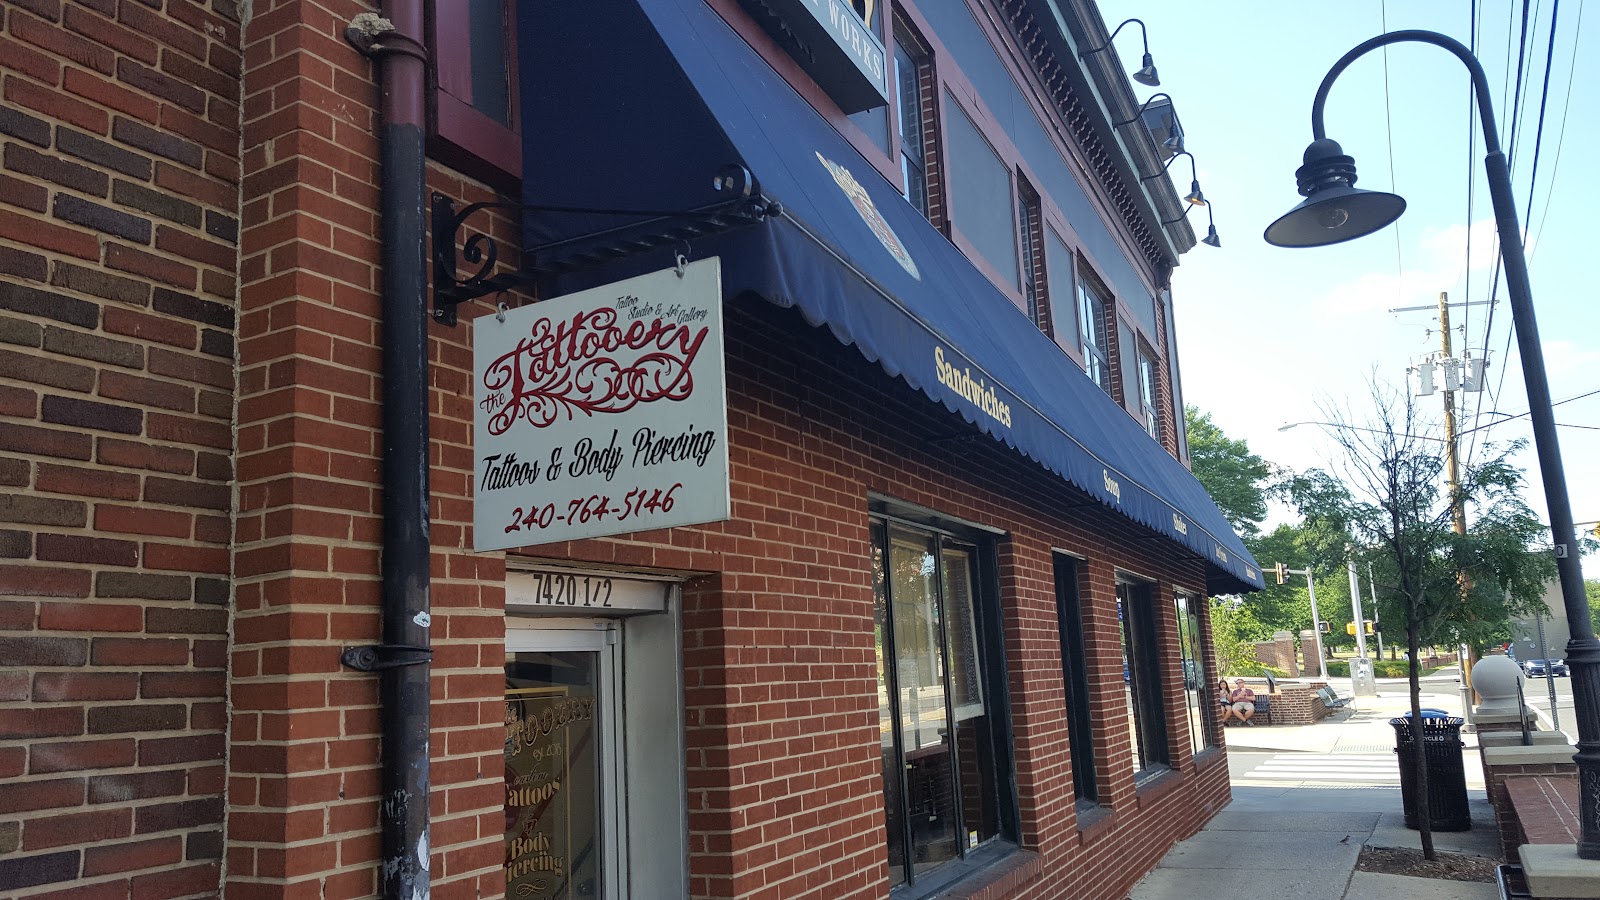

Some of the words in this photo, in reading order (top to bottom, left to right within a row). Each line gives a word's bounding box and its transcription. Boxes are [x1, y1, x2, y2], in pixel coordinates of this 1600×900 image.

[828, 0, 880, 79] WORKS
[616, 295, 639, 310] Tattoo
[628, 302, 653, 320] Studio
[655, 303, 662, 315] &
[660, 304, 681, 319] Art
[677, 306, 708, 325] Gallery
[484, 308, 709, 435] Tattooery
[934, 346, 1012, 429] Sandwiches
[480, 391, 506, 414] the
[481, 453, 540, 492] Tattoos
[546, 446, 562, 482] &
[568, 429, 624, 482] Body
[632, 424, 716, 467] Piercing
[504, 483, 682, 533] 240-764-5146
[533, 573, 577, 606] 7420
[583, 577, 613, 607] 1/2
[511, 831, 550, 860] Body
[507, 850, 563, 882] iercing
